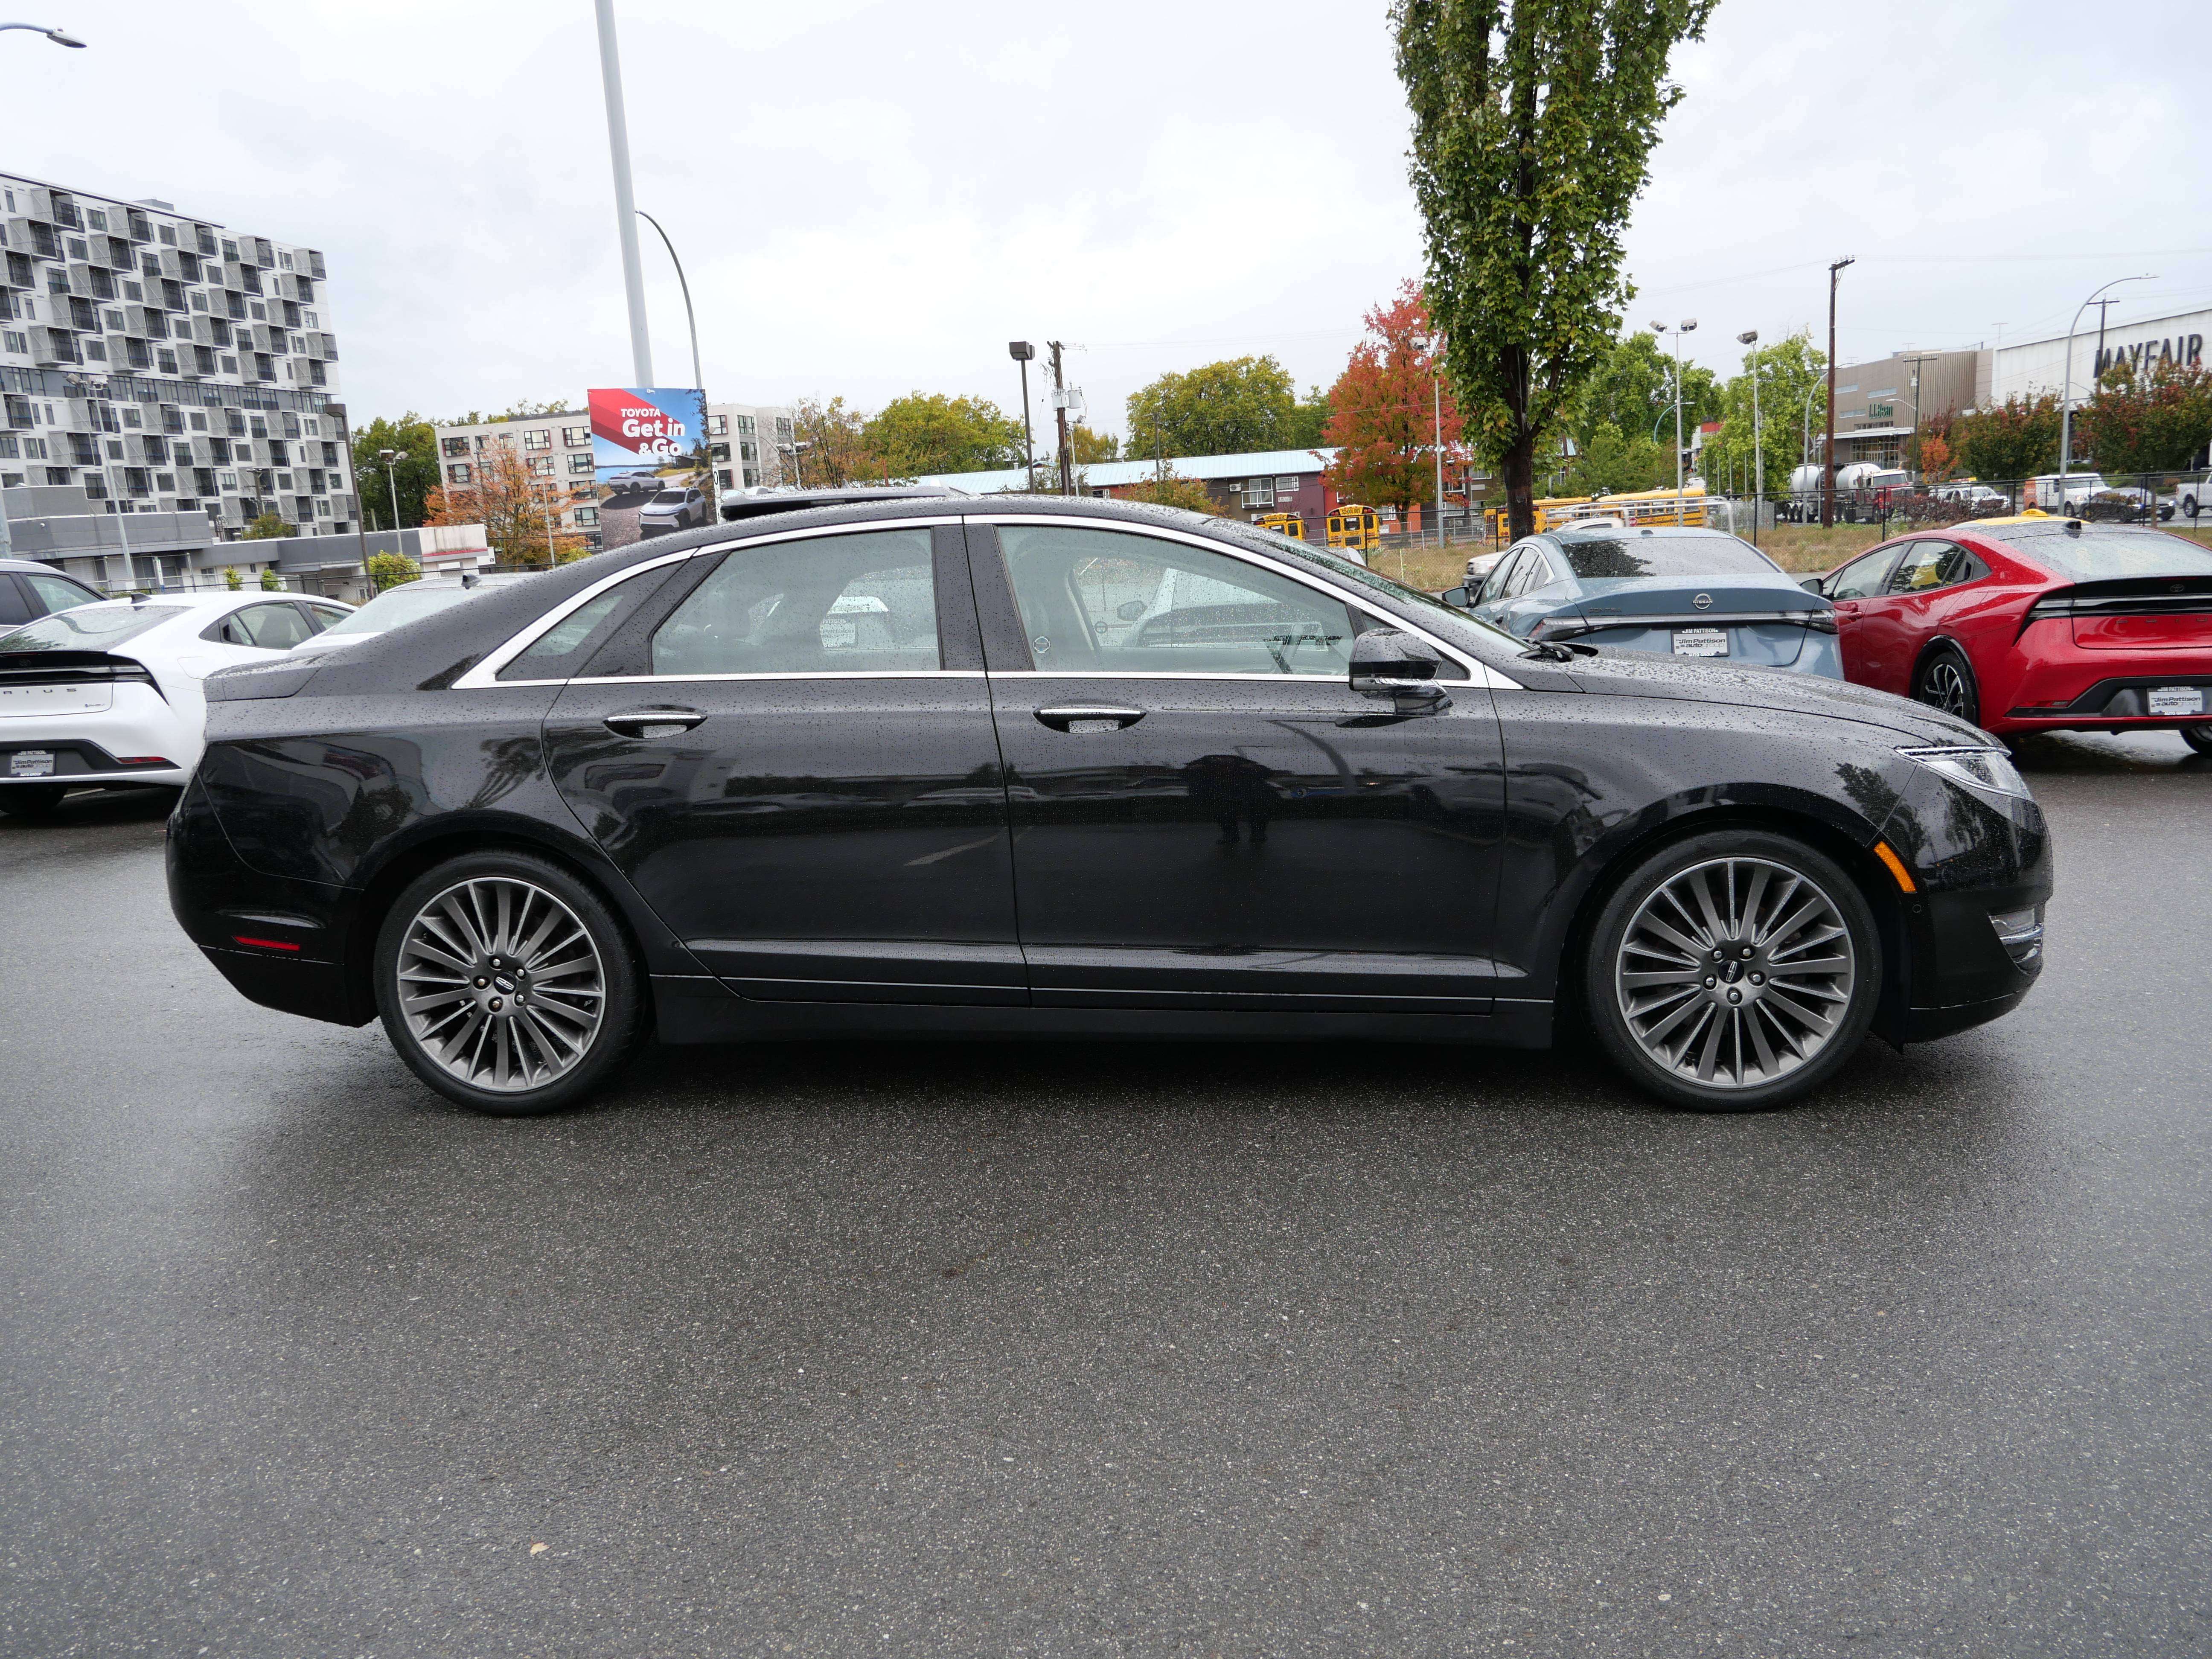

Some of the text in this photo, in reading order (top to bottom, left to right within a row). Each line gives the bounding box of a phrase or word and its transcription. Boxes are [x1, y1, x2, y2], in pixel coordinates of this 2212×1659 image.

[2093, 334, 2203, 378] MAYFAIR
[620, 408, 661, 417] TOYOTA
[623, 417, 685, 437] Get in
